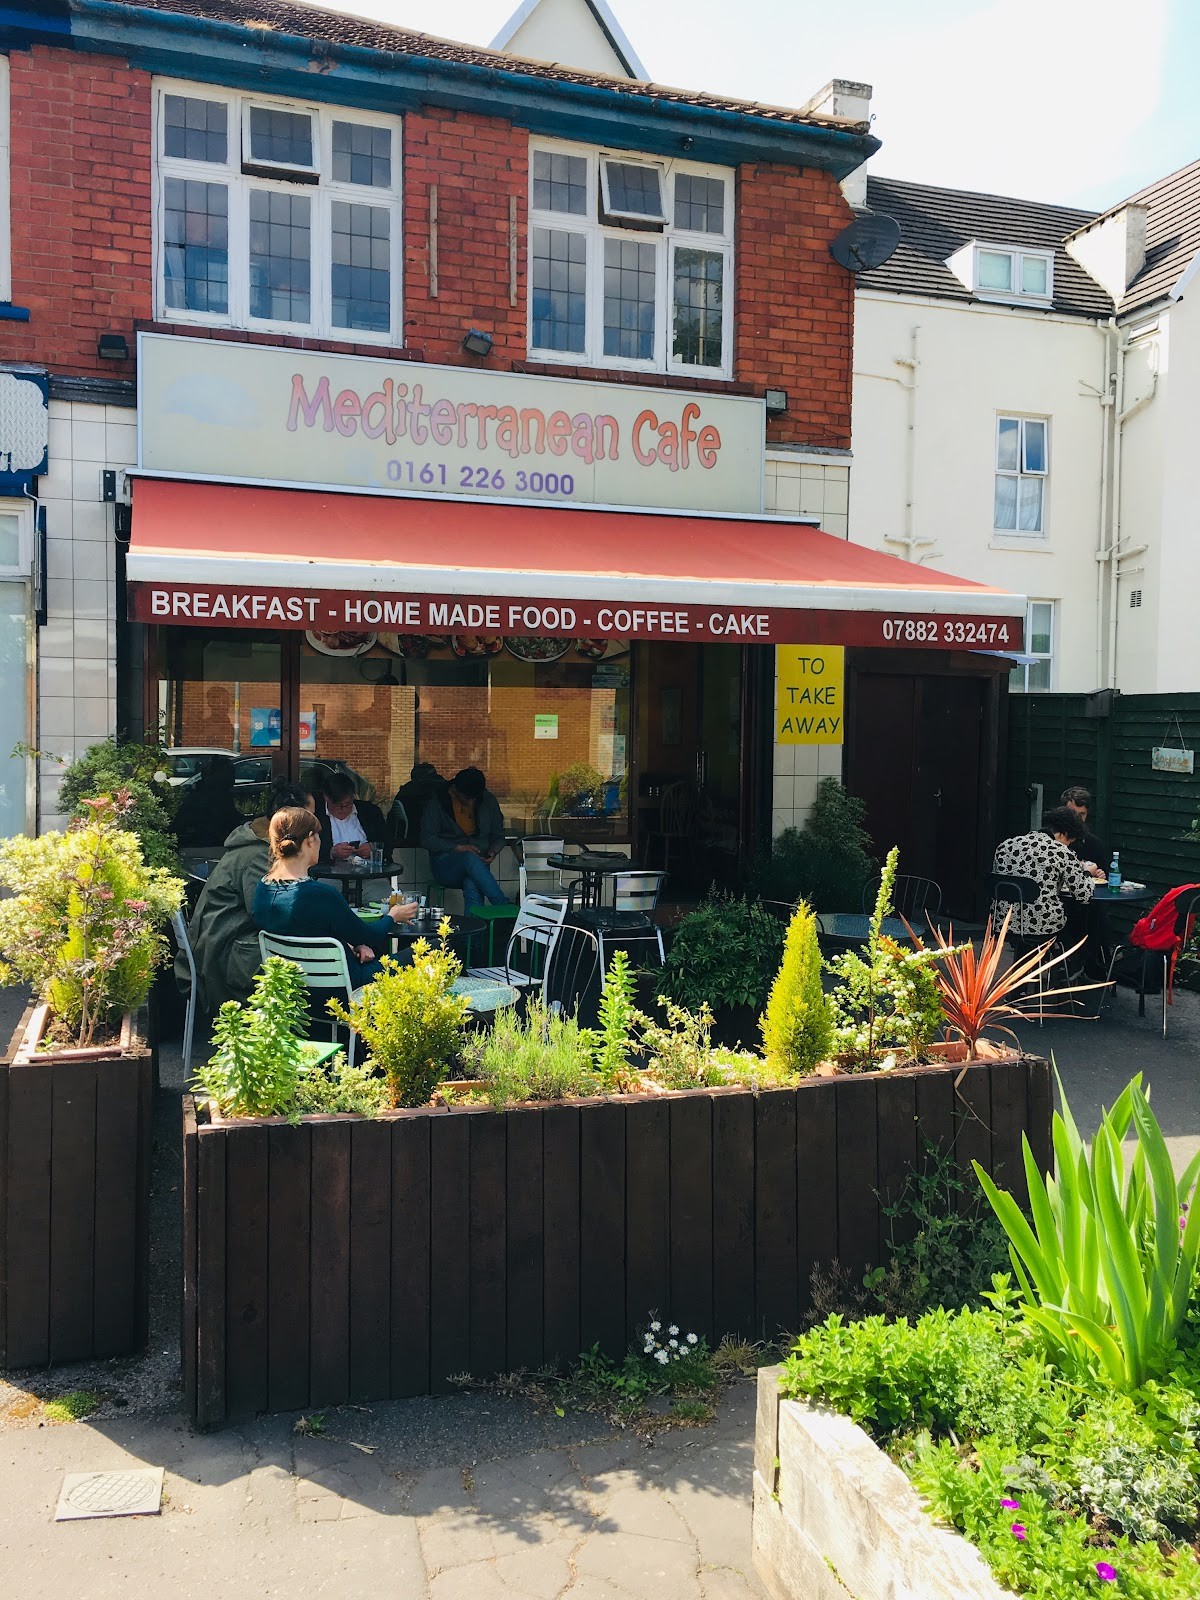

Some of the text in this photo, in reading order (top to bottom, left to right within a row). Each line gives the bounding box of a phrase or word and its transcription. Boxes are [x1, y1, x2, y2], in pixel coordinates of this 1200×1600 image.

[286, 373, 722, 472] Mediterranean Cafe
[386, 459, 575, 496] 0161 226 3000
[151, 590, 321, 622] BREAKFAST
[344, 599, 421, 625] HOME
[428, 602, 501, 628] MADE
[508, 605, 577, 631] FOOD
[597, 608, 690, 634] COFFEE
[708, 613, 770, 636] CAKE
[882, 619, 938, 642] 07882
[943, 621, 1010, 644] 332474
[797, 657, 825, 675] TO
[786, 686, 836, 705] TAKE
[781, 716, 841, 735] AWAY
